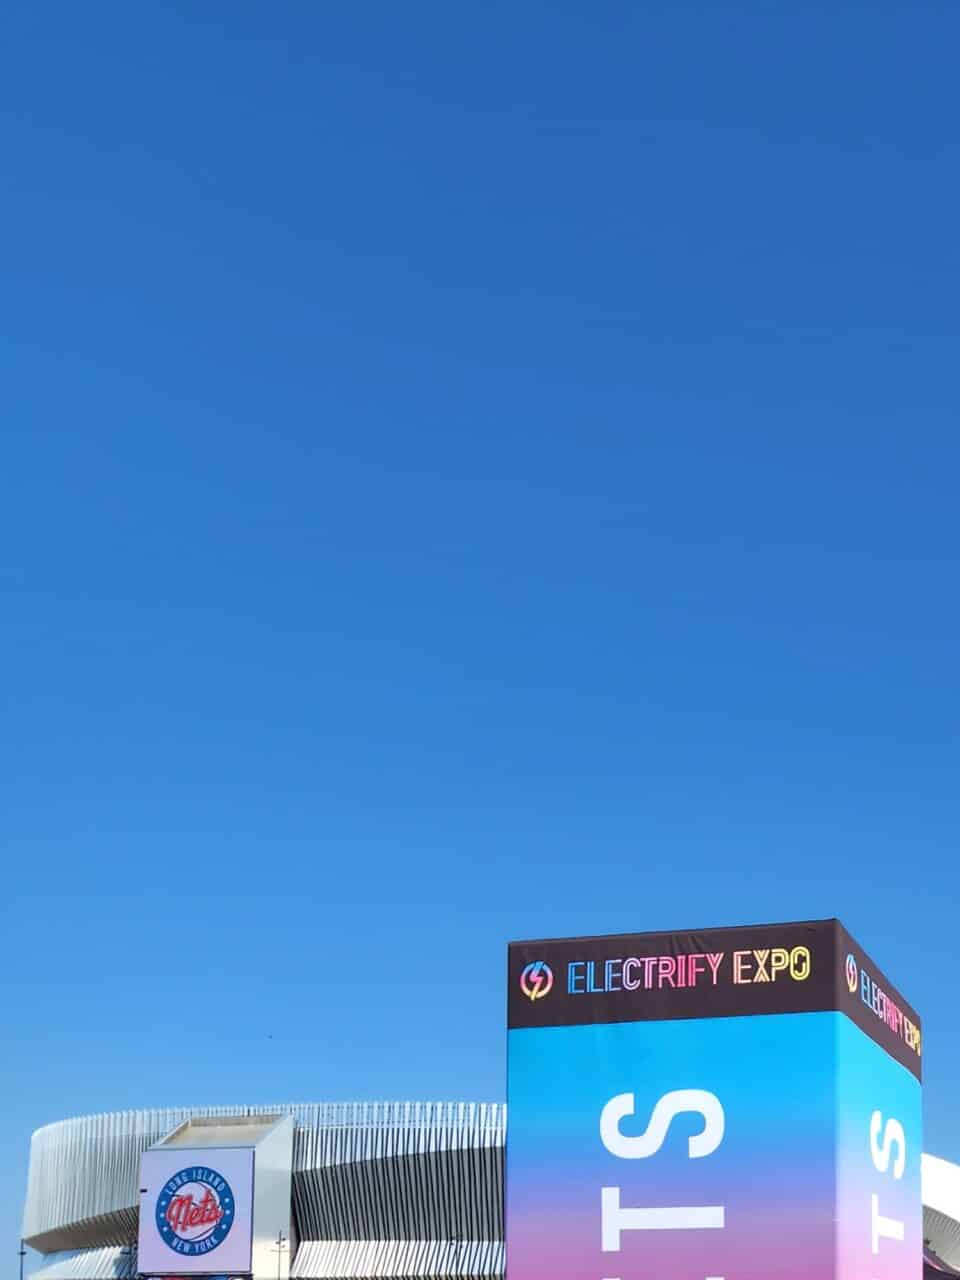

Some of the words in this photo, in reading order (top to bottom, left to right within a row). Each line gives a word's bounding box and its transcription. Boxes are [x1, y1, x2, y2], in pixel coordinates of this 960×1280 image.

[567, 952, 725, 995] ELECTRIFY
[733, 946, 811, 985] EXPO
[860, 968, 904, 1039] ELECTRIFY
[165, 1171, 188, 1195] LONG
[192, 1169, 226, 1192] ISLAND
[166, 1189, 225, 1232] Nets
[172, 1237, 191, 1254] NEW
[195, 1236, 218, 1253] YORK
